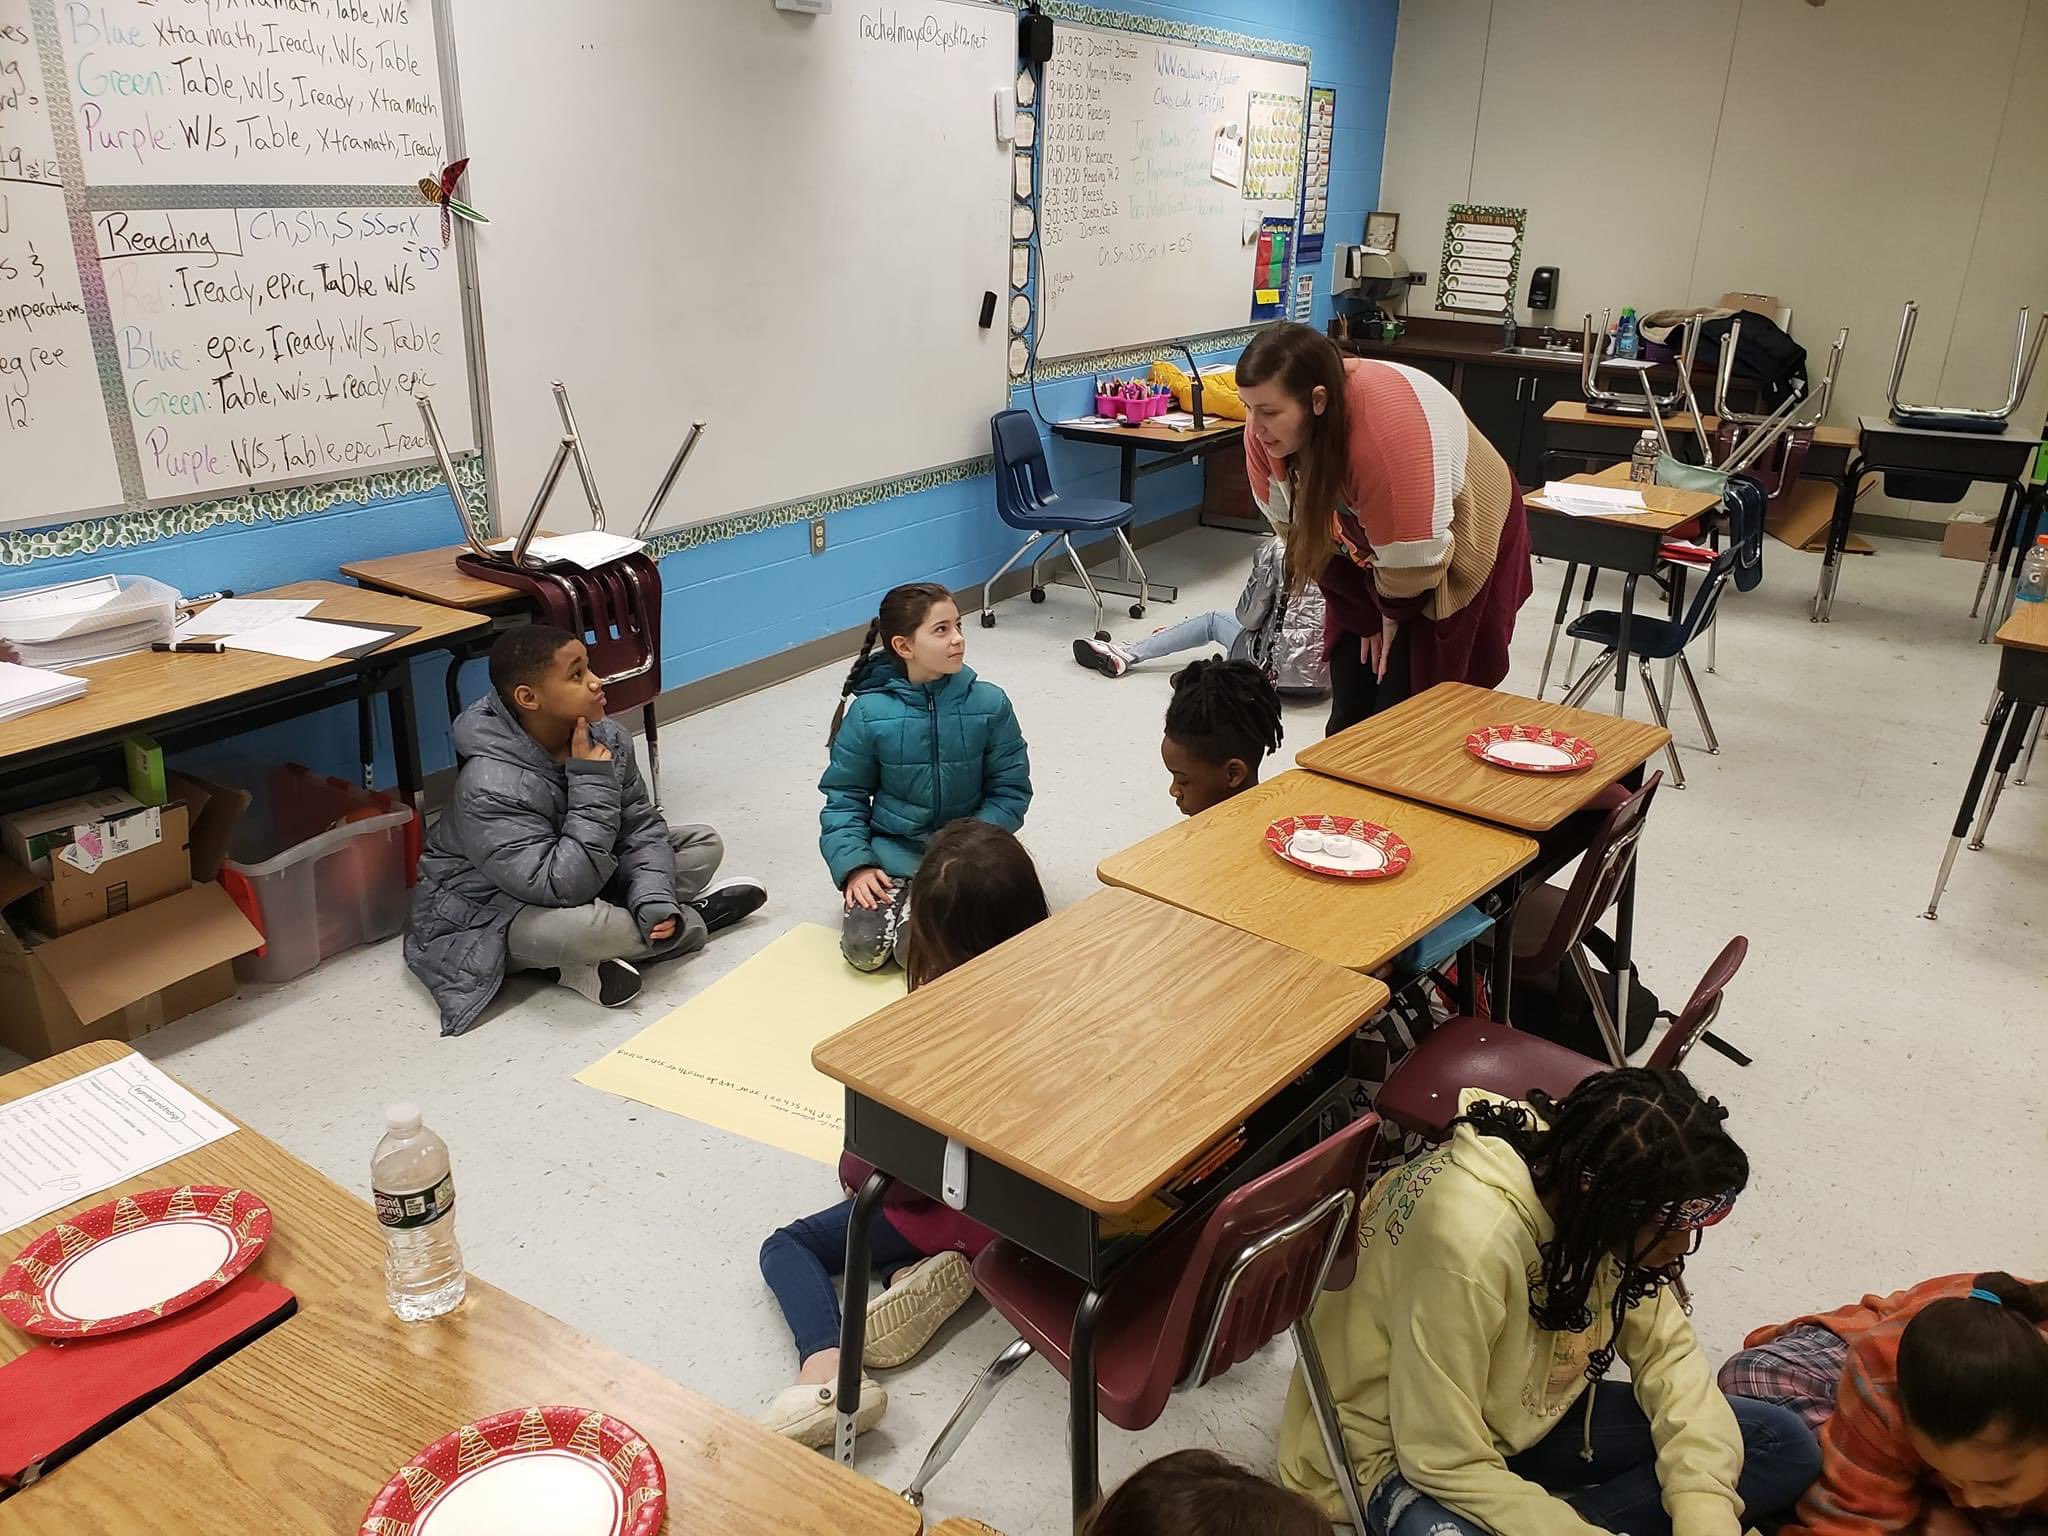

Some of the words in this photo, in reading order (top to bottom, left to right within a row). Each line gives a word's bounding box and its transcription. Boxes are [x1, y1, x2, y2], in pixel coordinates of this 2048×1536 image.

[375, 39, 421, 76] Table
[1476, 214, 1493, 223] YOUR
[1494, 216, 1517, 225] HANDS
[98, 212, 219, 268] Reading
[313, 258, 377, 298] Table
[0, 291, 85, 333] emperatures
[383, 319, 444, 355] Table
[0, 347, 70, 398] egree
[376, 422, 434, 450] Iread
